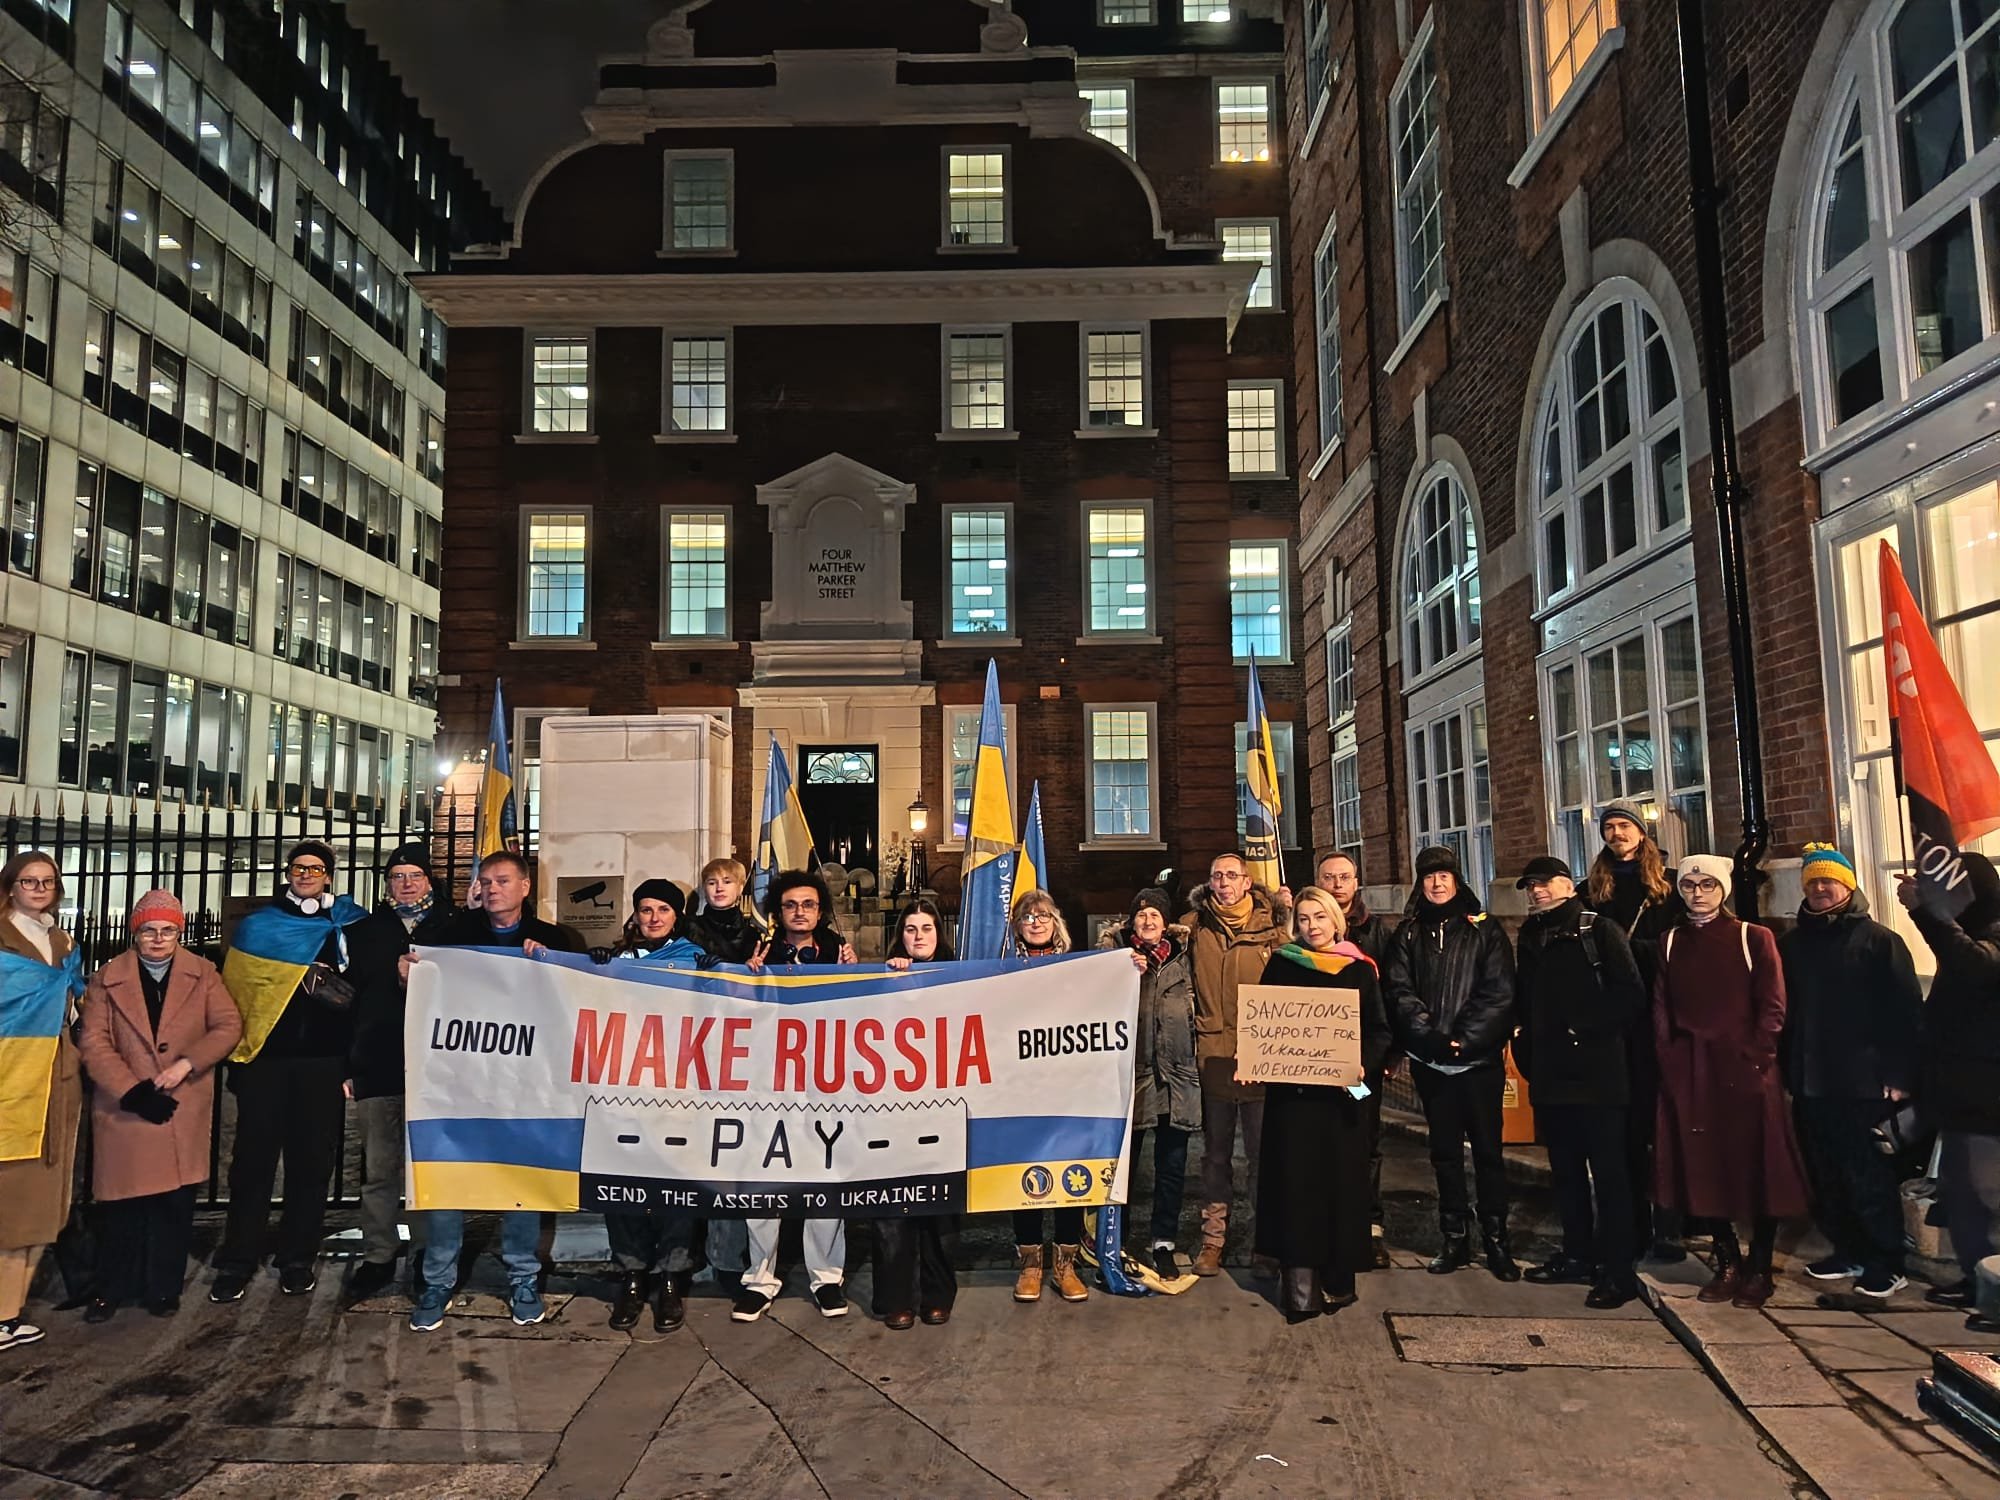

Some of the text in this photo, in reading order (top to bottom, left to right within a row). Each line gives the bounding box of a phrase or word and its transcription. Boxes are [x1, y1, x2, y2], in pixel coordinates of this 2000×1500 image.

[821, 549, 853, 560] FOUR
[808, 562, 866, 573] MATTHEW
[817, 575, 857, 586] PARKER
[818, 588, 856, 599] STREET
[431, 1018, 536, 1057] LONDON
[1017, 1020, 1129, 1060] BRUSSELS
[1333, 1028, 1361, 1041] FOR
[570, 1008, 992, 1095] MAKE RUSSIA
[1251, 1062, 1270, 1076] NO
[597, 1184, 950, 1209] SEND THE ASSETS TO UKRAINE!!
